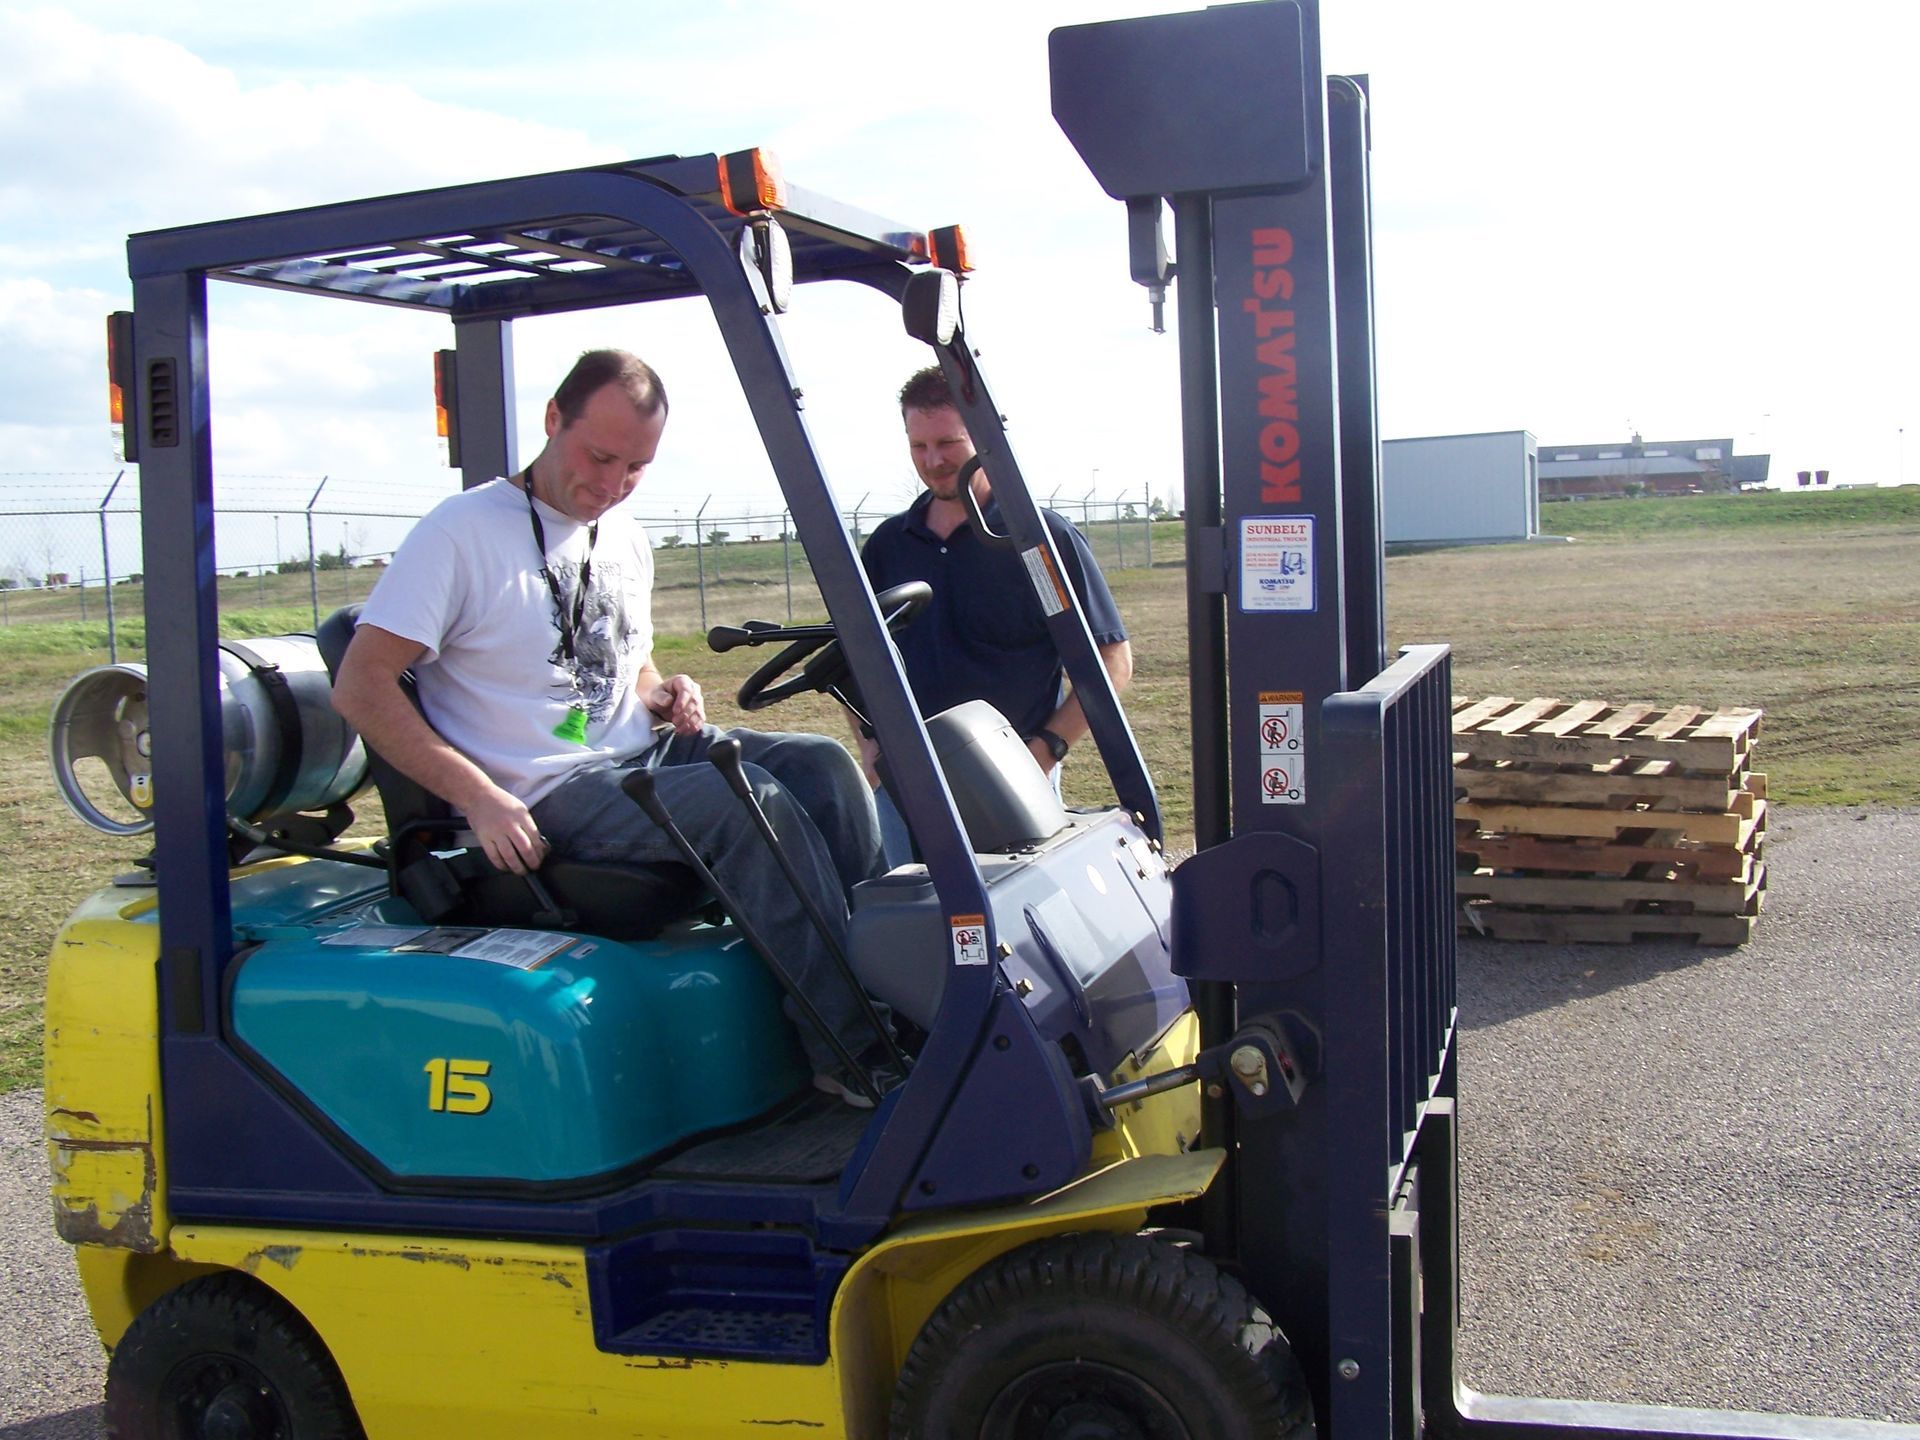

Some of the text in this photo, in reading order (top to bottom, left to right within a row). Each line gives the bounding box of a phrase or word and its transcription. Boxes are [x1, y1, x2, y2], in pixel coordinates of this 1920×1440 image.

[1243, 227, 1302, 503] KOMATSU
[1247, 525, 1306, 534] SUNBELT
[424, 1058, 492, 1114] 15
